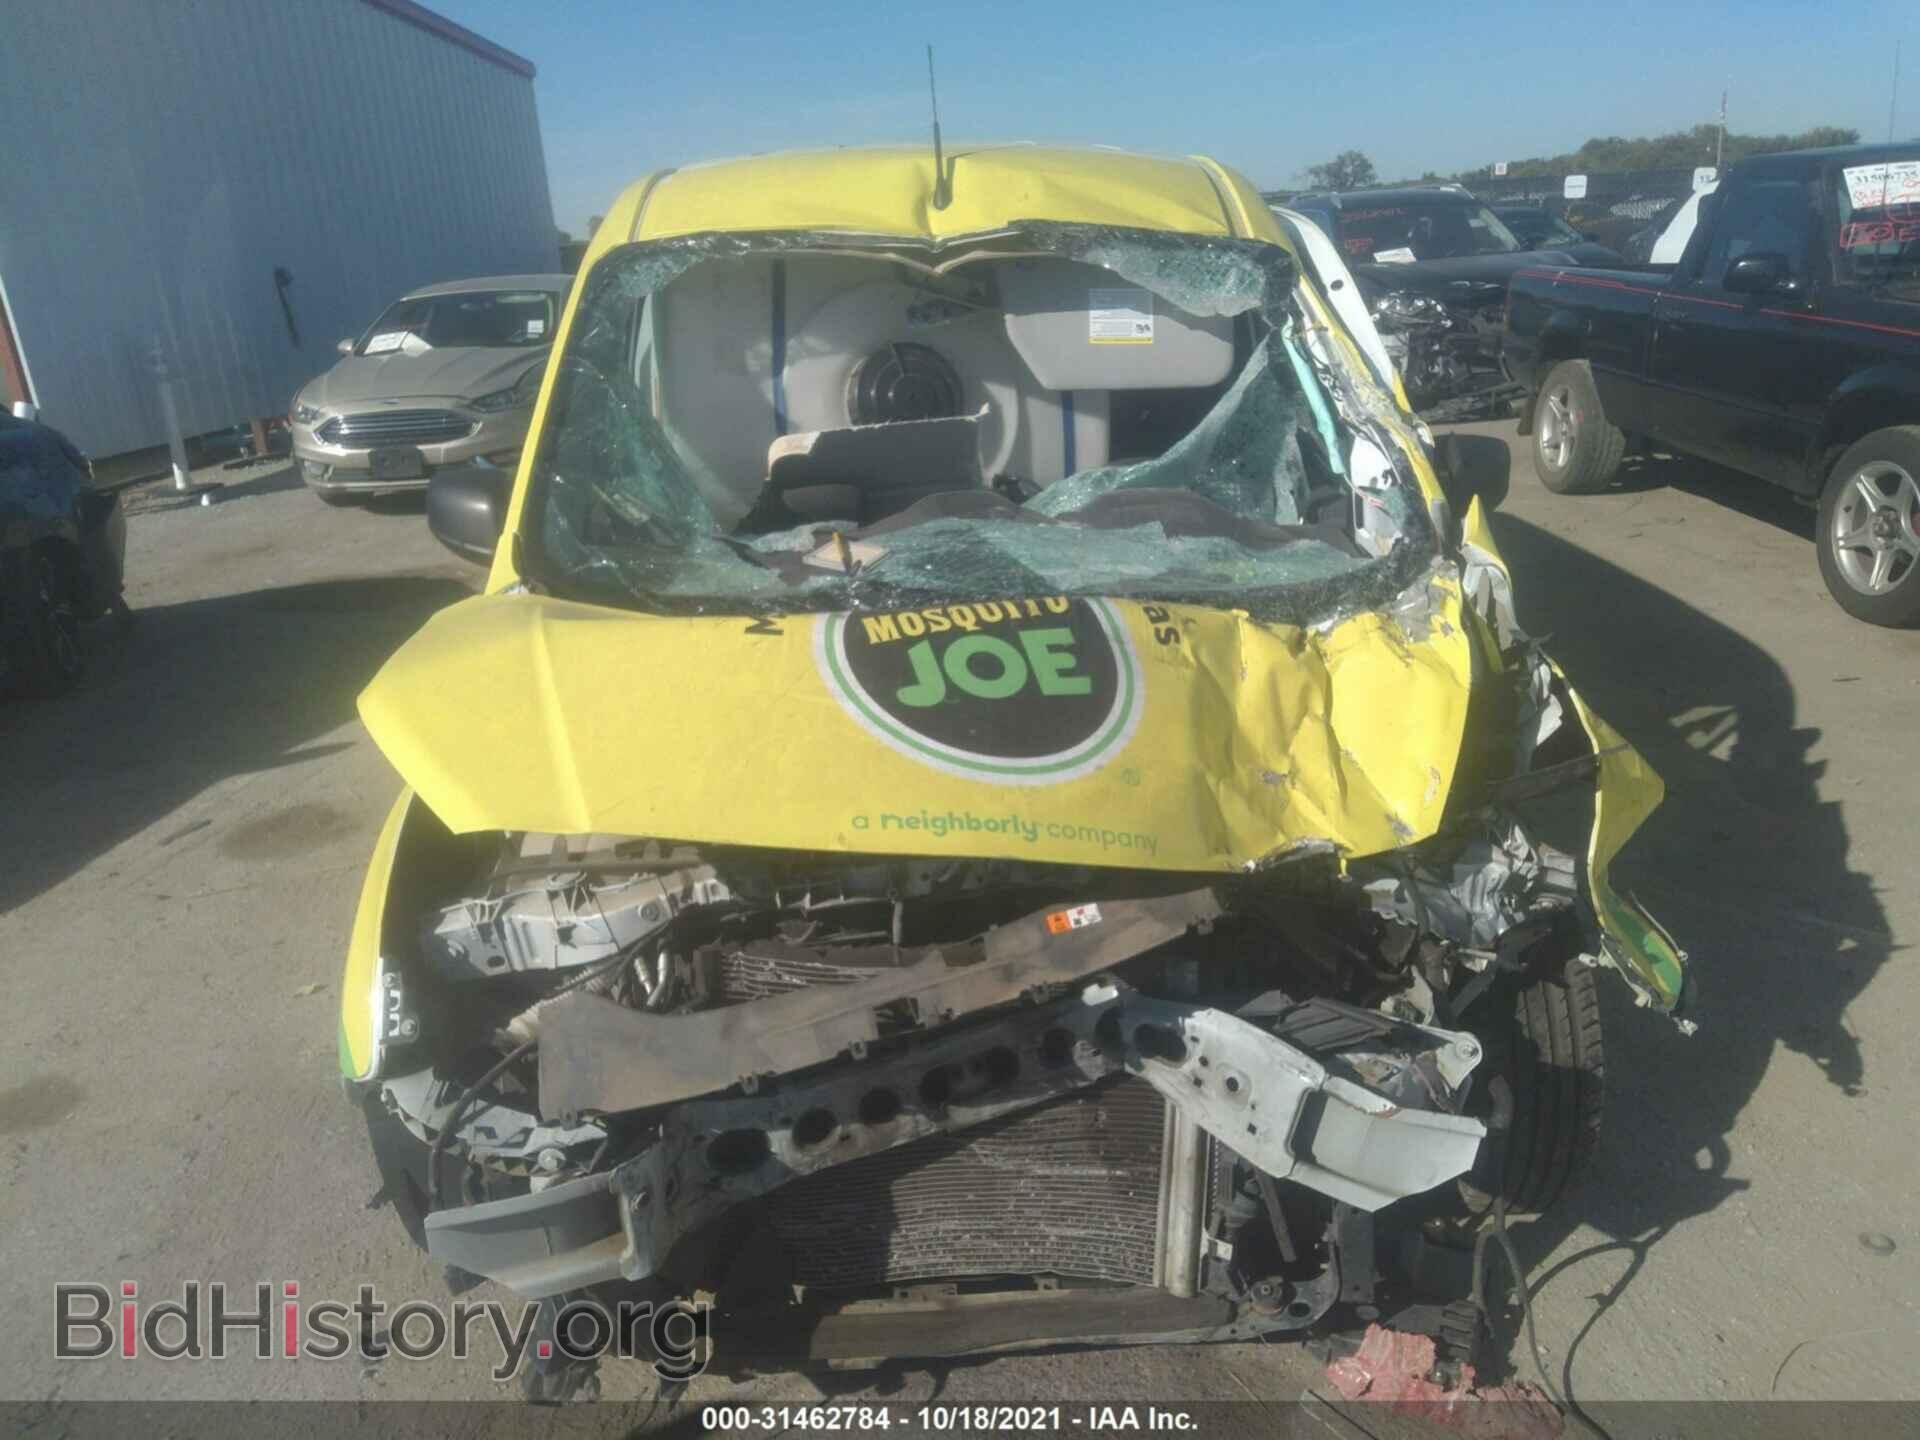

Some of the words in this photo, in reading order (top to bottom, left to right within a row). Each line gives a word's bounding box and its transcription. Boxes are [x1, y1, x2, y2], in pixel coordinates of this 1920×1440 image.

[896, 627, 1092, 708] JOE
[852, 813, 869, 830] a
[880, 810, 1039, 842] neighborly
[1046, 821, 1158, 856] company
